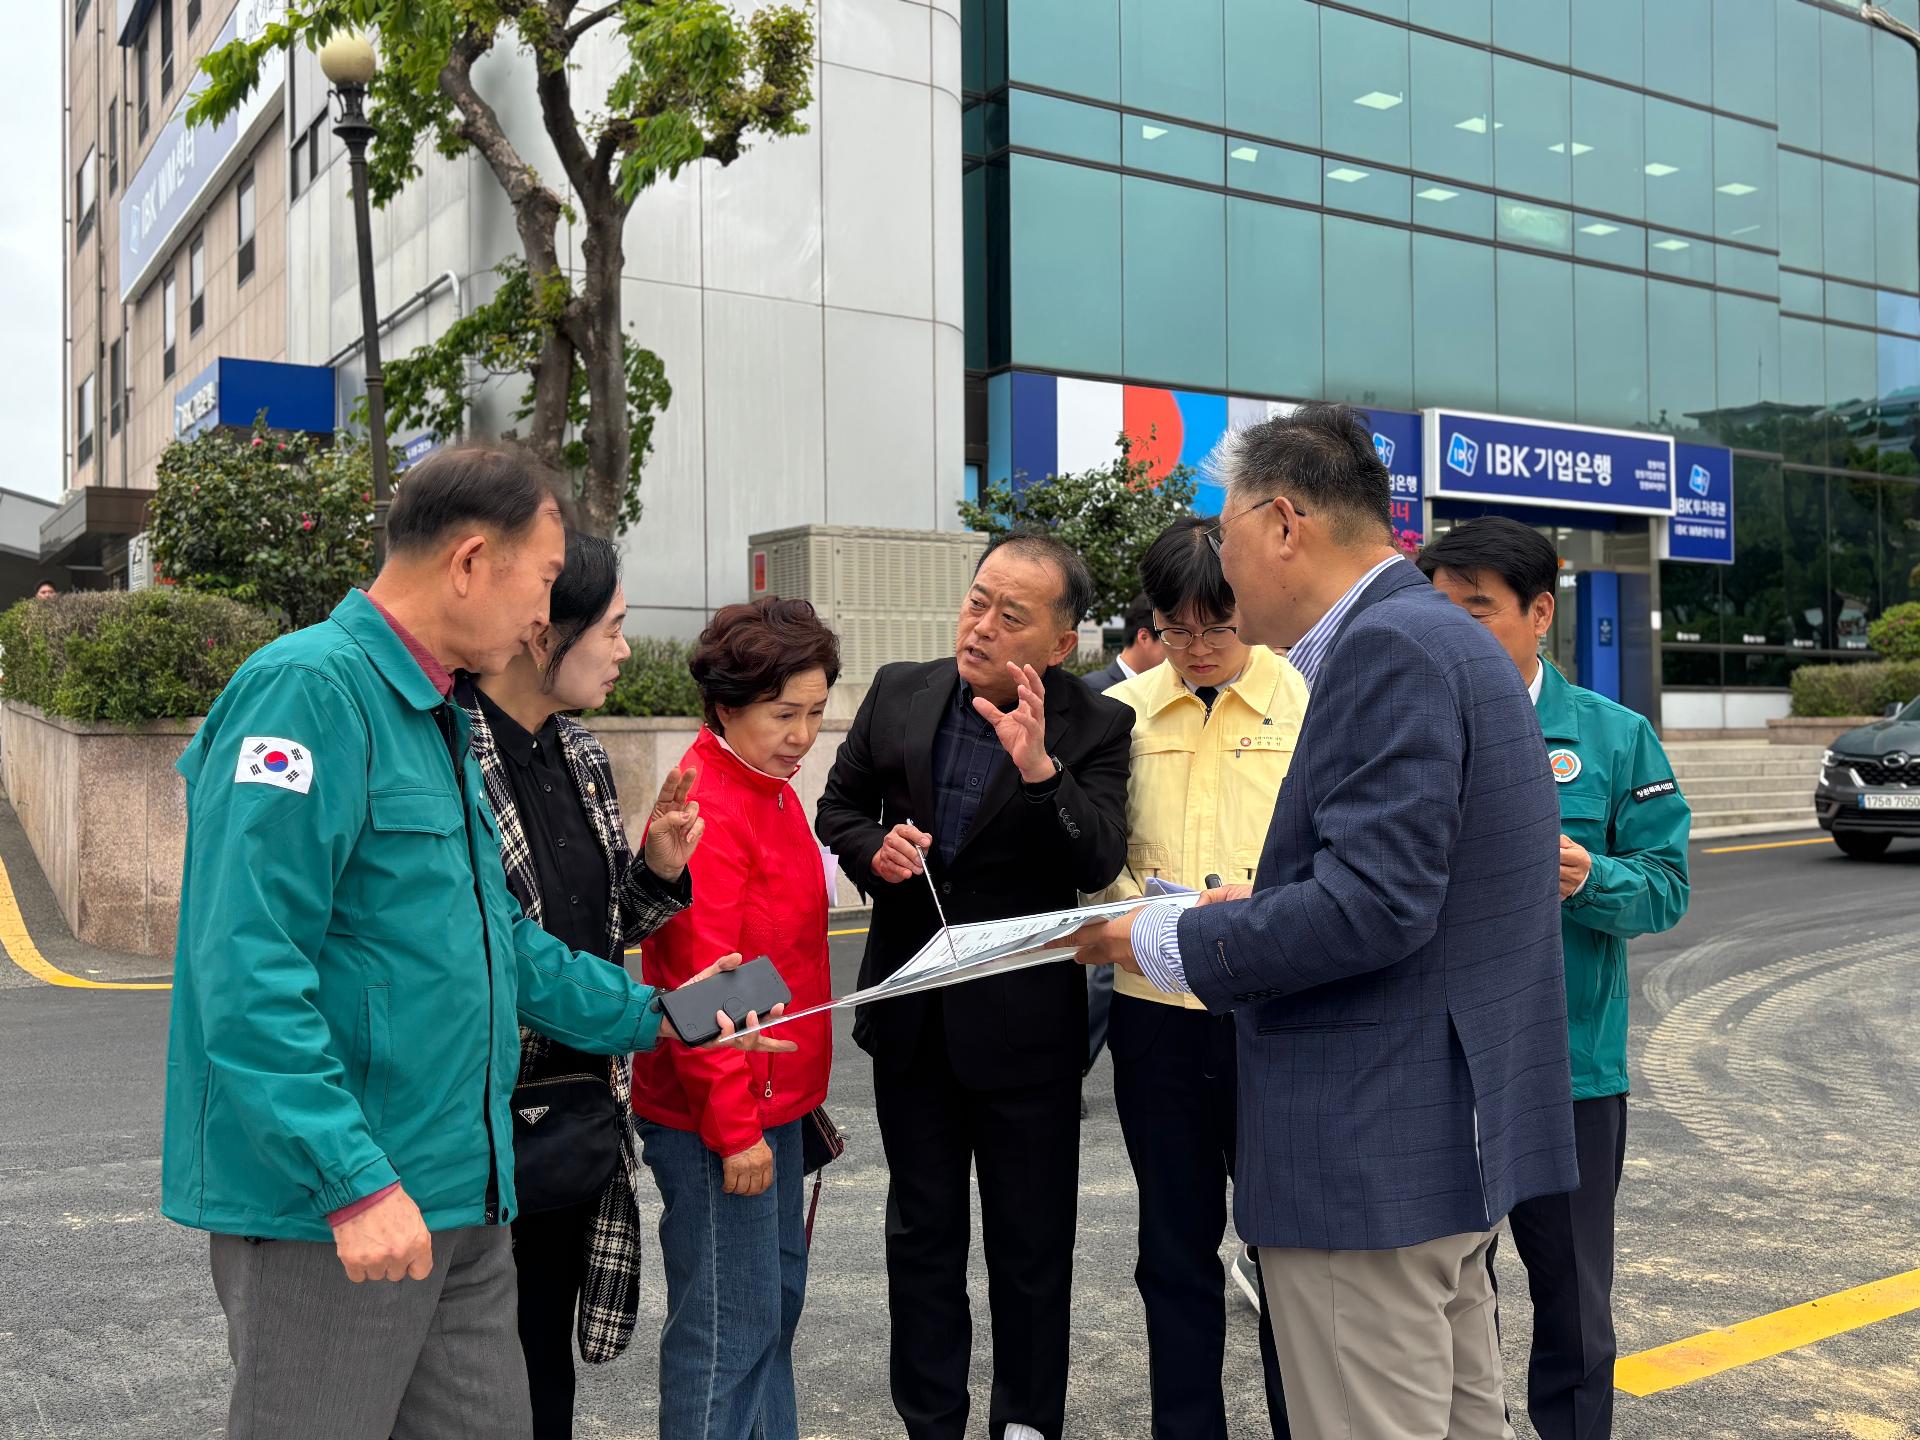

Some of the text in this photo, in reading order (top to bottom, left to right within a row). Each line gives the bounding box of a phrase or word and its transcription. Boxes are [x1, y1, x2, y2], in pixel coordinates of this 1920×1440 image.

[1486, 442, 1612, 487] IBK 기업은행
[1677, 497, 1726, 518] BK투자증권
[1893, 796, 1920, 808] 7050
